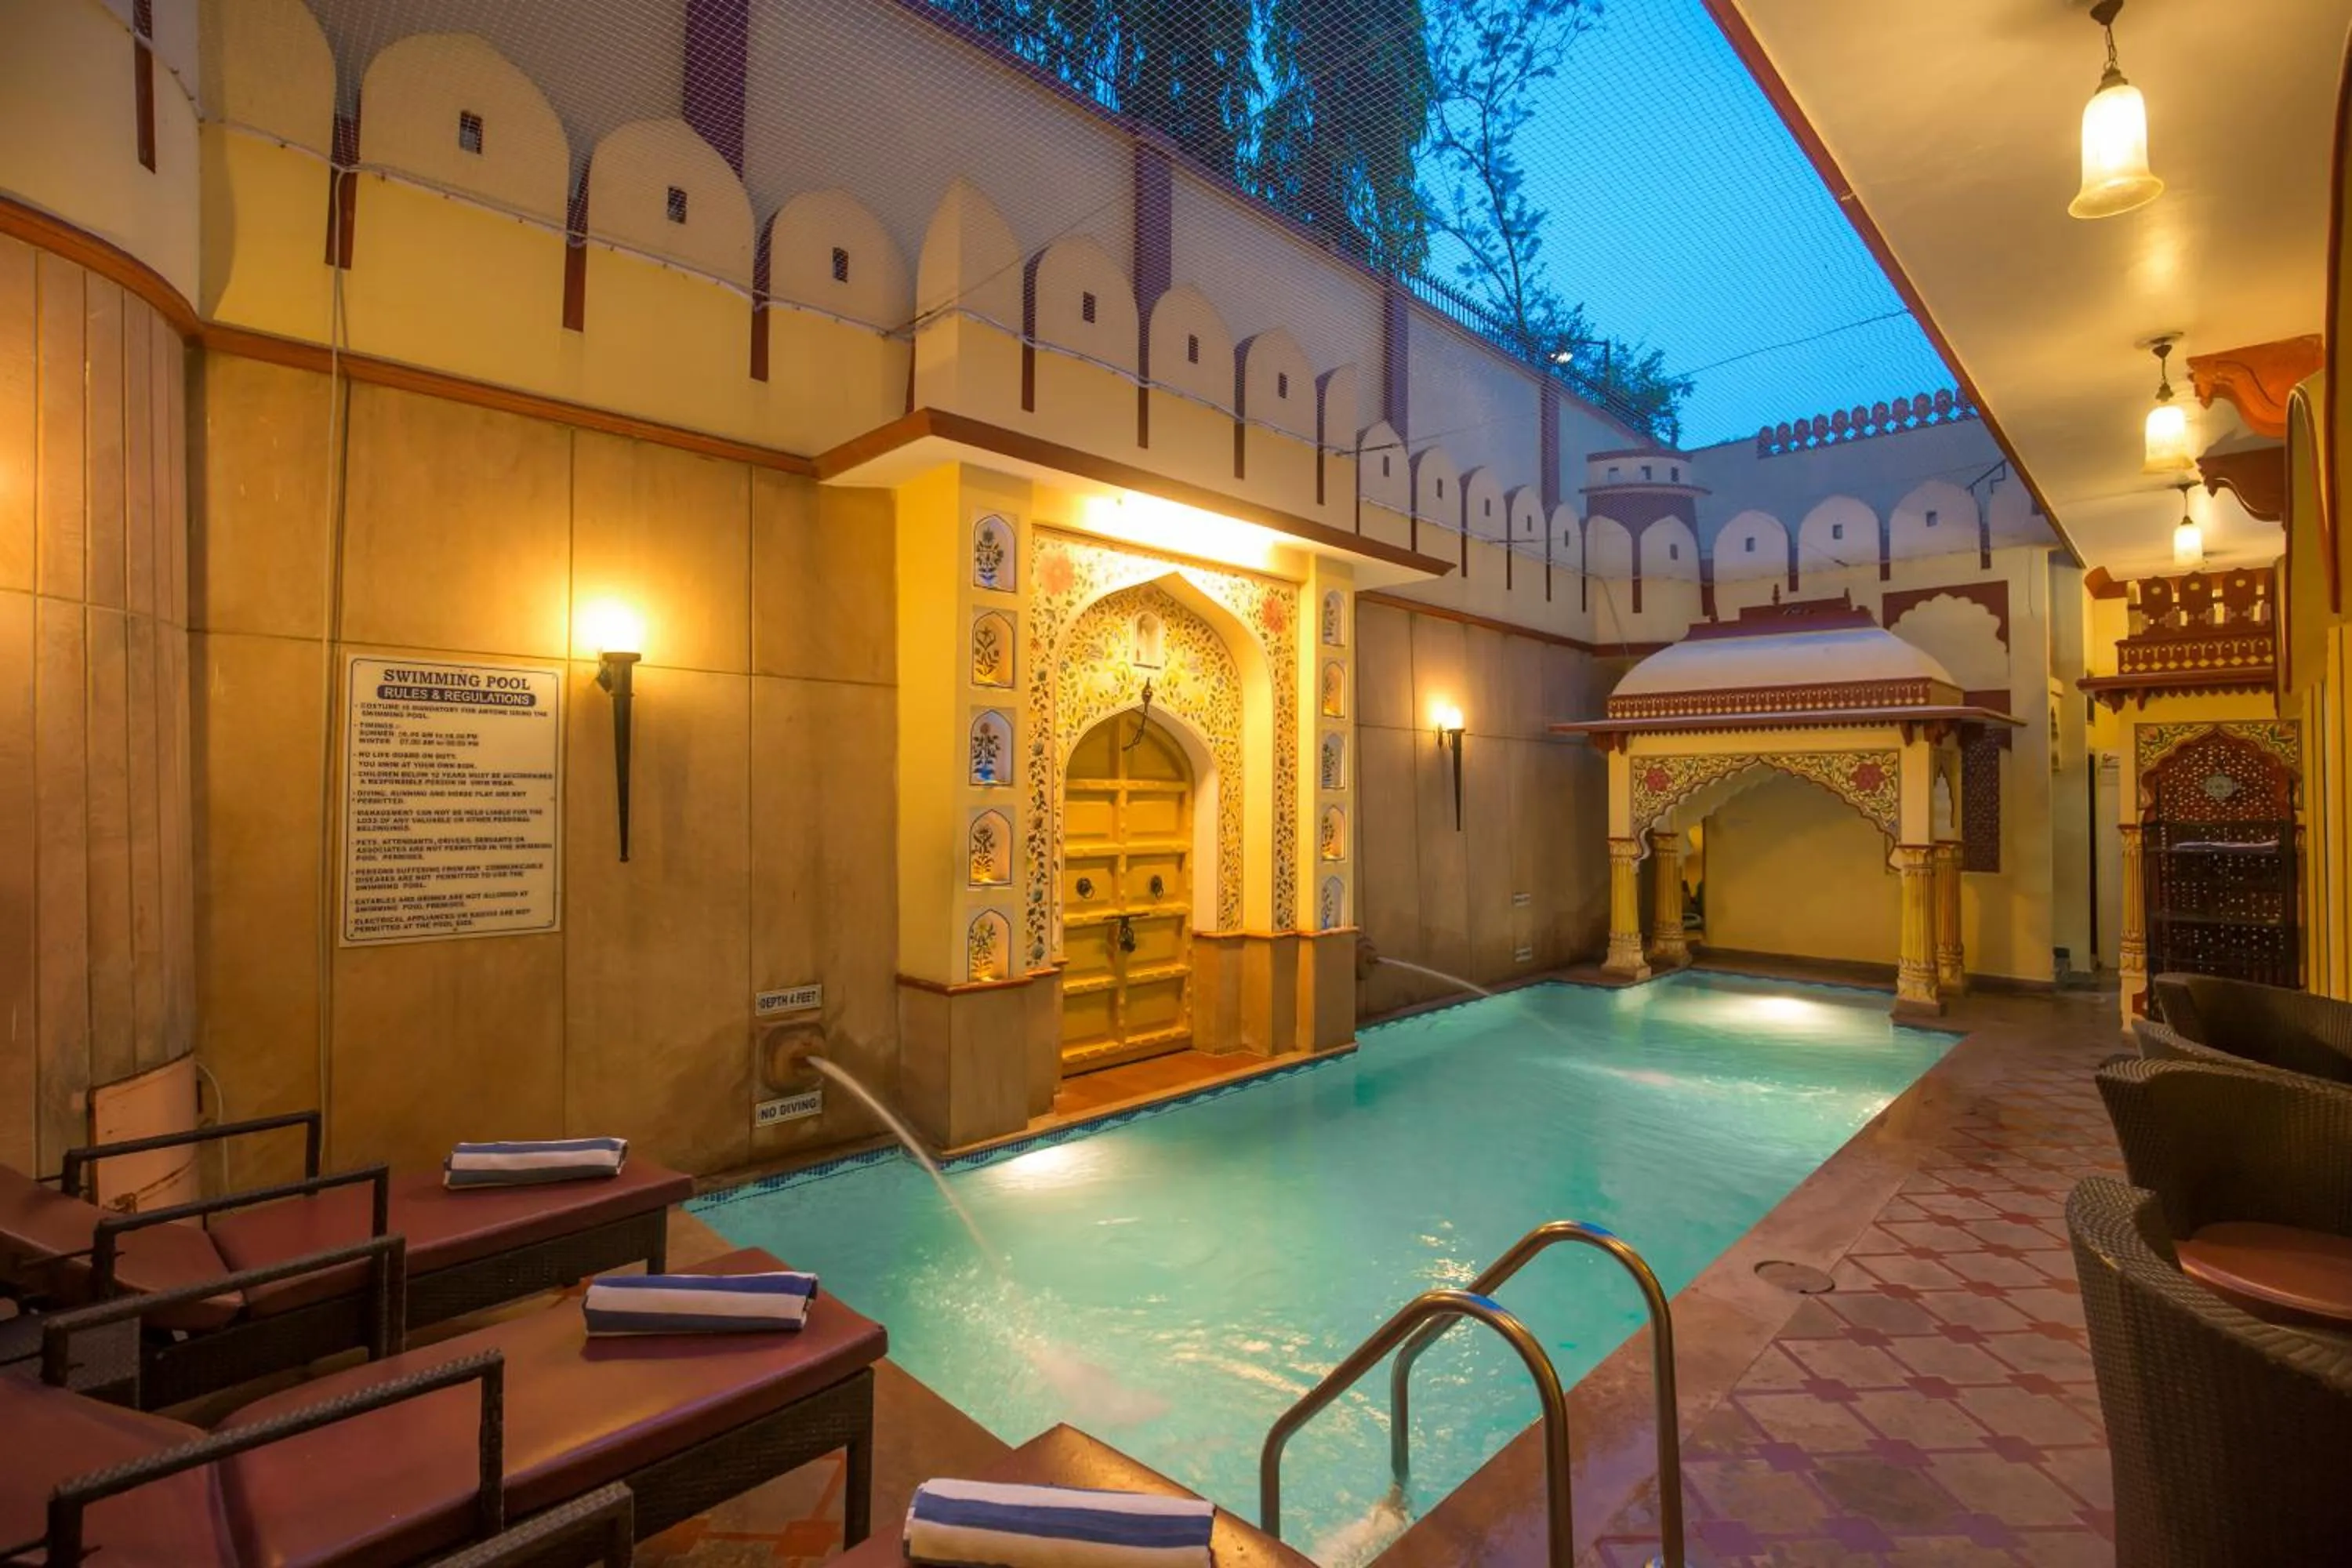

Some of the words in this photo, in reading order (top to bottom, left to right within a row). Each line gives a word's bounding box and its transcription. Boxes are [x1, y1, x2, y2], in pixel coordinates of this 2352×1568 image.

[383, 669, 481, 688] SWIMMING
[486, 676, 531, 691] POOL
[384, 687, 428, 699] RULES
[431, 689, 440, 699] &
[445, 691, 530, 706] REGULATIONS
[760, 994, 788, 1009] DEPTH
[797, 991, 816, 1004] FEET
[760, 1106, 777, 1120] NO
[780, 1098, 817, 1116] DIVING
